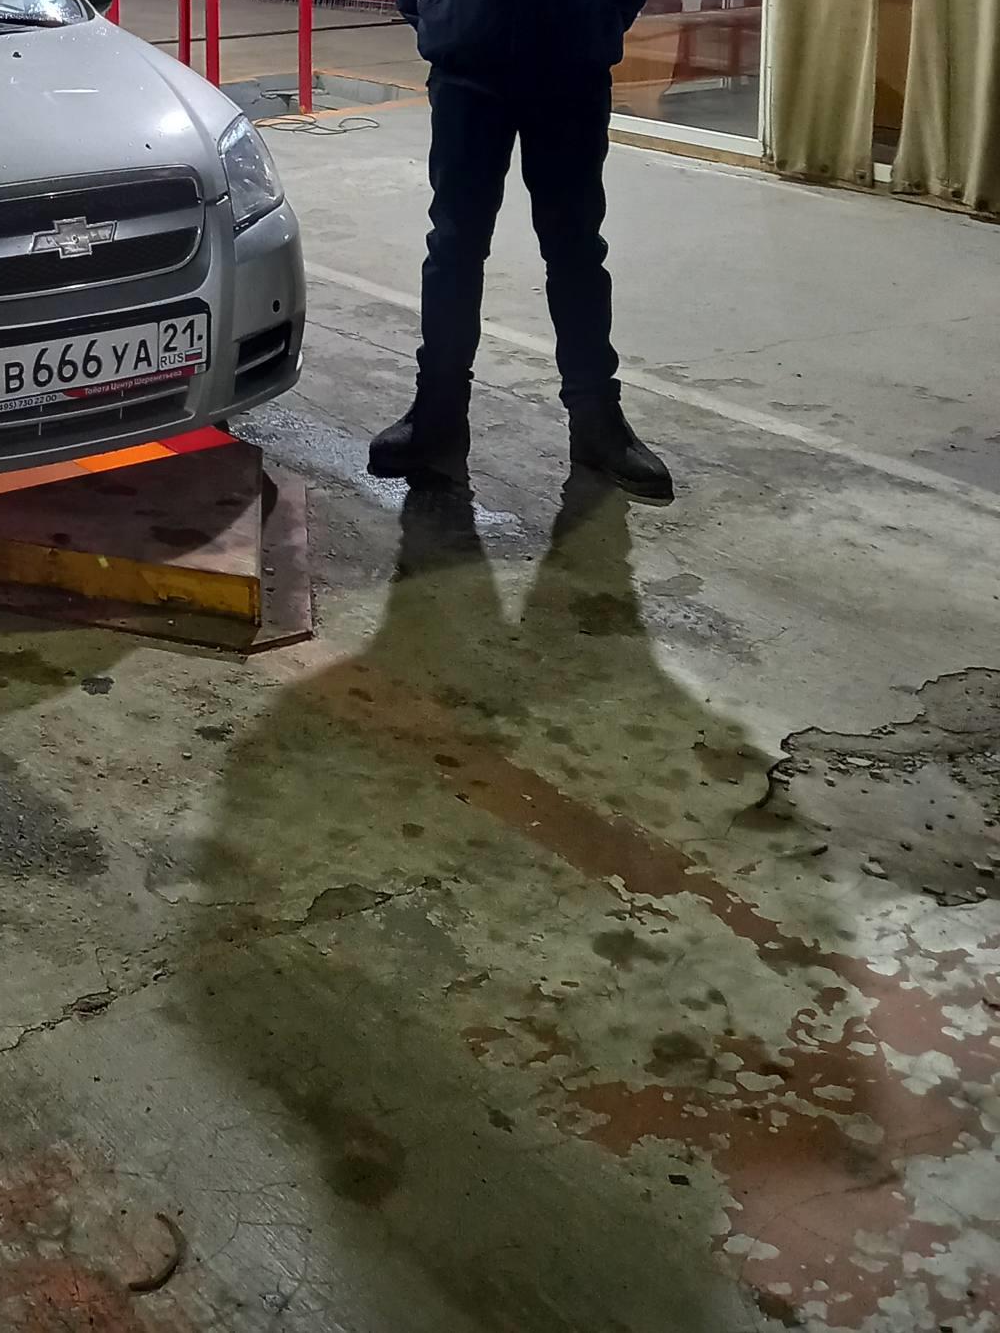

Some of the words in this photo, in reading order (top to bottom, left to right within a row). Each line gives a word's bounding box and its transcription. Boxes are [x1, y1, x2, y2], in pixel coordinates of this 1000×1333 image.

[162, 319, 196, 353] 21
[160, 352, 184, 368] RUS
[84, 384, 110, 396] Тойота
[110, 380, 133, 390] Центр
[19, 398, 33, 407] 730
[45, 394, 57, 403] 00
